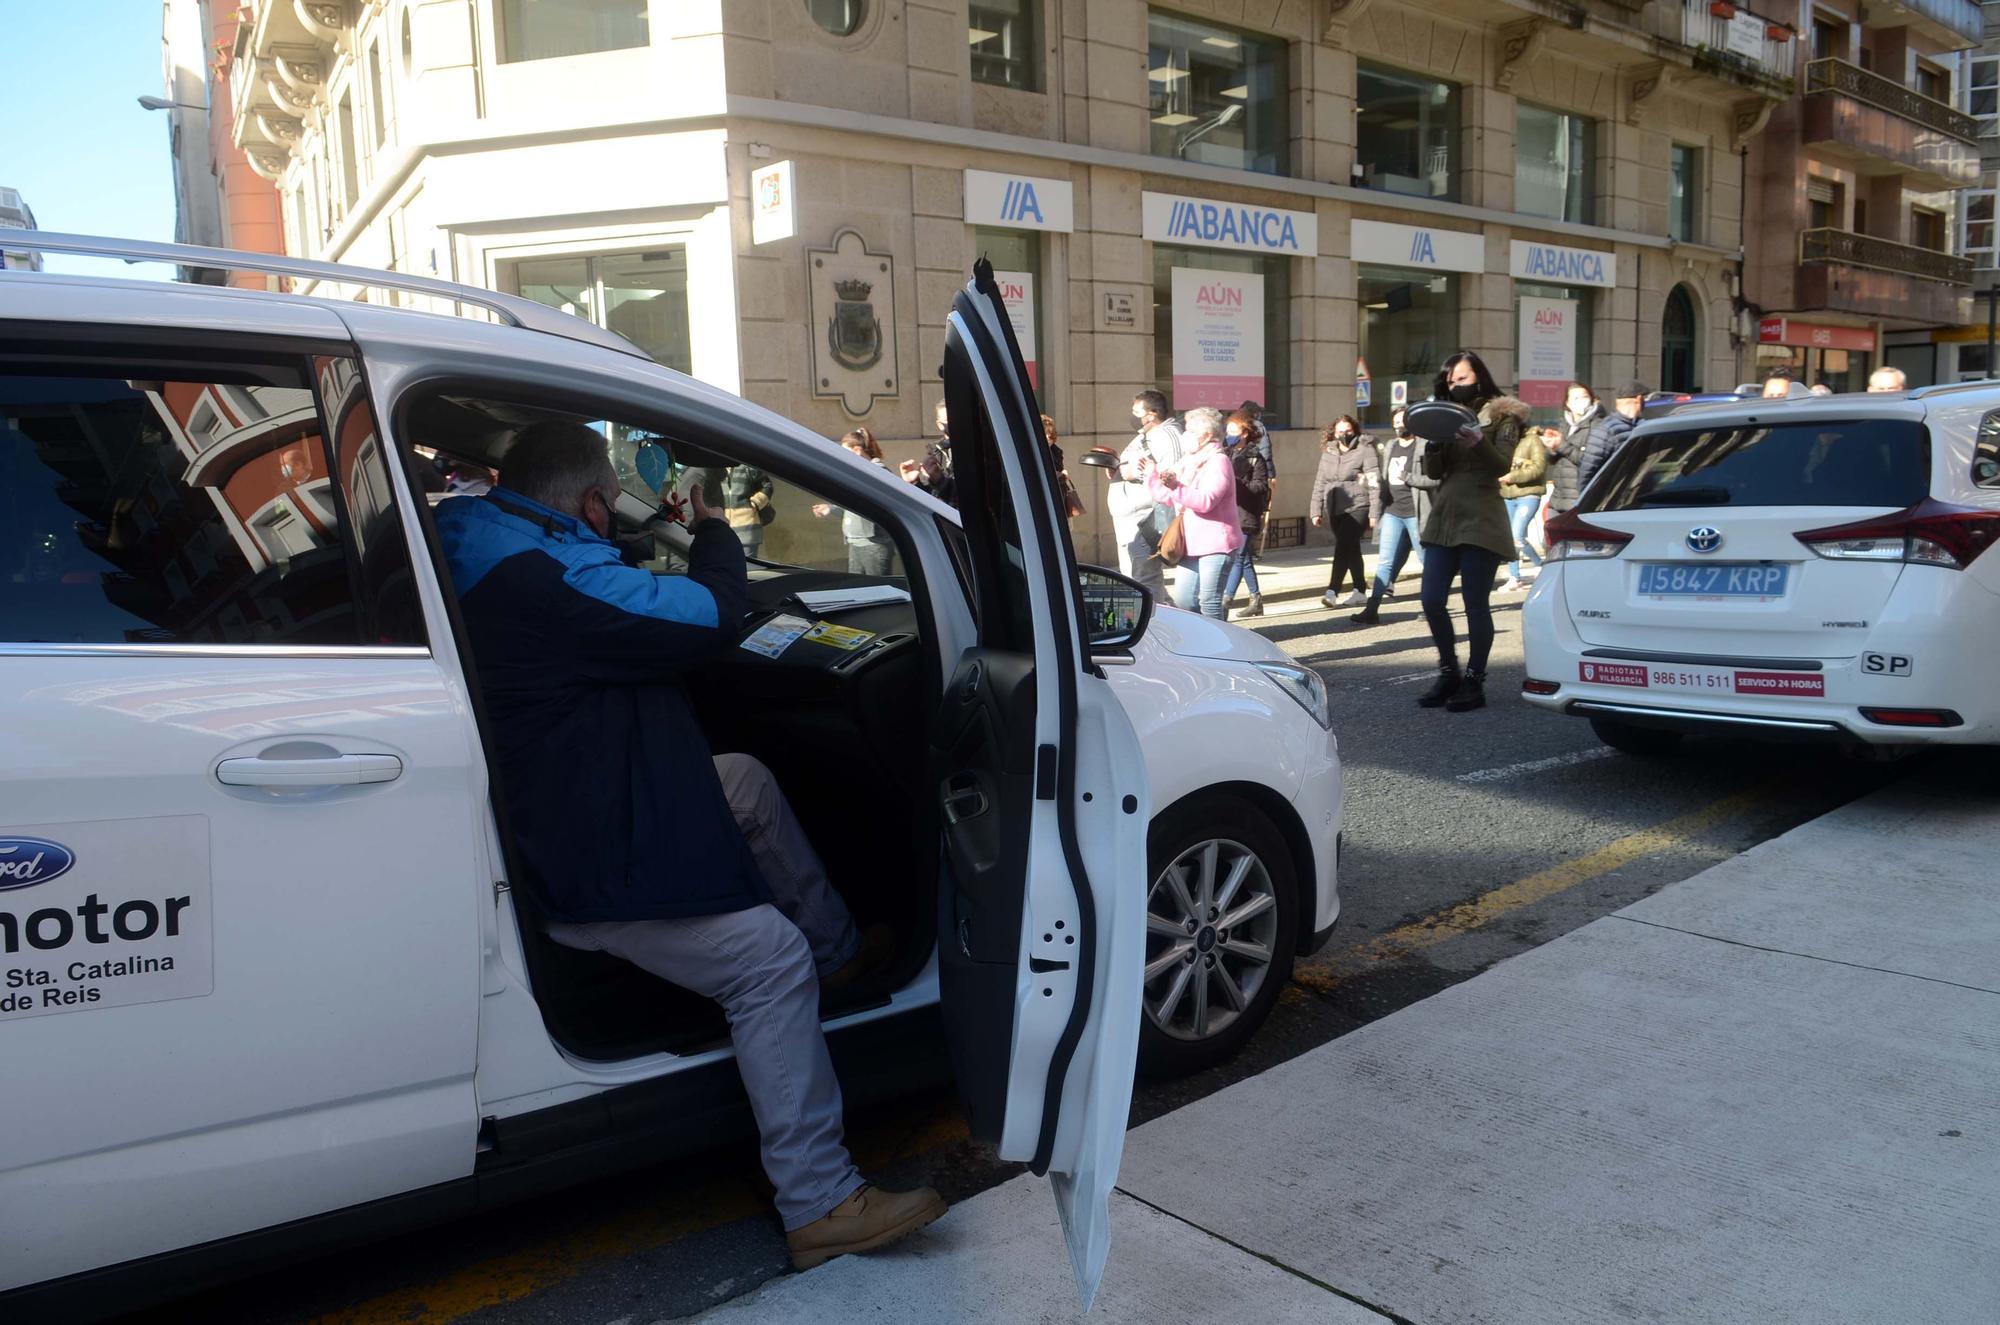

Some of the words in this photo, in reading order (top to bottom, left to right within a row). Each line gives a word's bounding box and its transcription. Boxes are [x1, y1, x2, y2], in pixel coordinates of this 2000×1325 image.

[1196, 281, 1242, 306] AÚN
[1535, 307, 1563, 326] AÚN
[1655, 567, 1721, 591] 5847
[1728, 567, 1781, 592] KRP
[1598, 665, 1644, 676] RADIOTAXI
[1653, 671, 1676, 685] 986
[1680, 673, 1701, 686] 511
[1706, 674, 1729, 688] 511
[1738, 678, 1776, 687] SERVICIO
[1778, 679, 1789, 688] 24
[1791, 680, 1822, 689] HORAS
[6, 968, 58, 988] Sta.
[67, 955, 174, 982] Catalina
[0, 992, 33, 1012] de
[43, 985, 101, 1007] Reis
